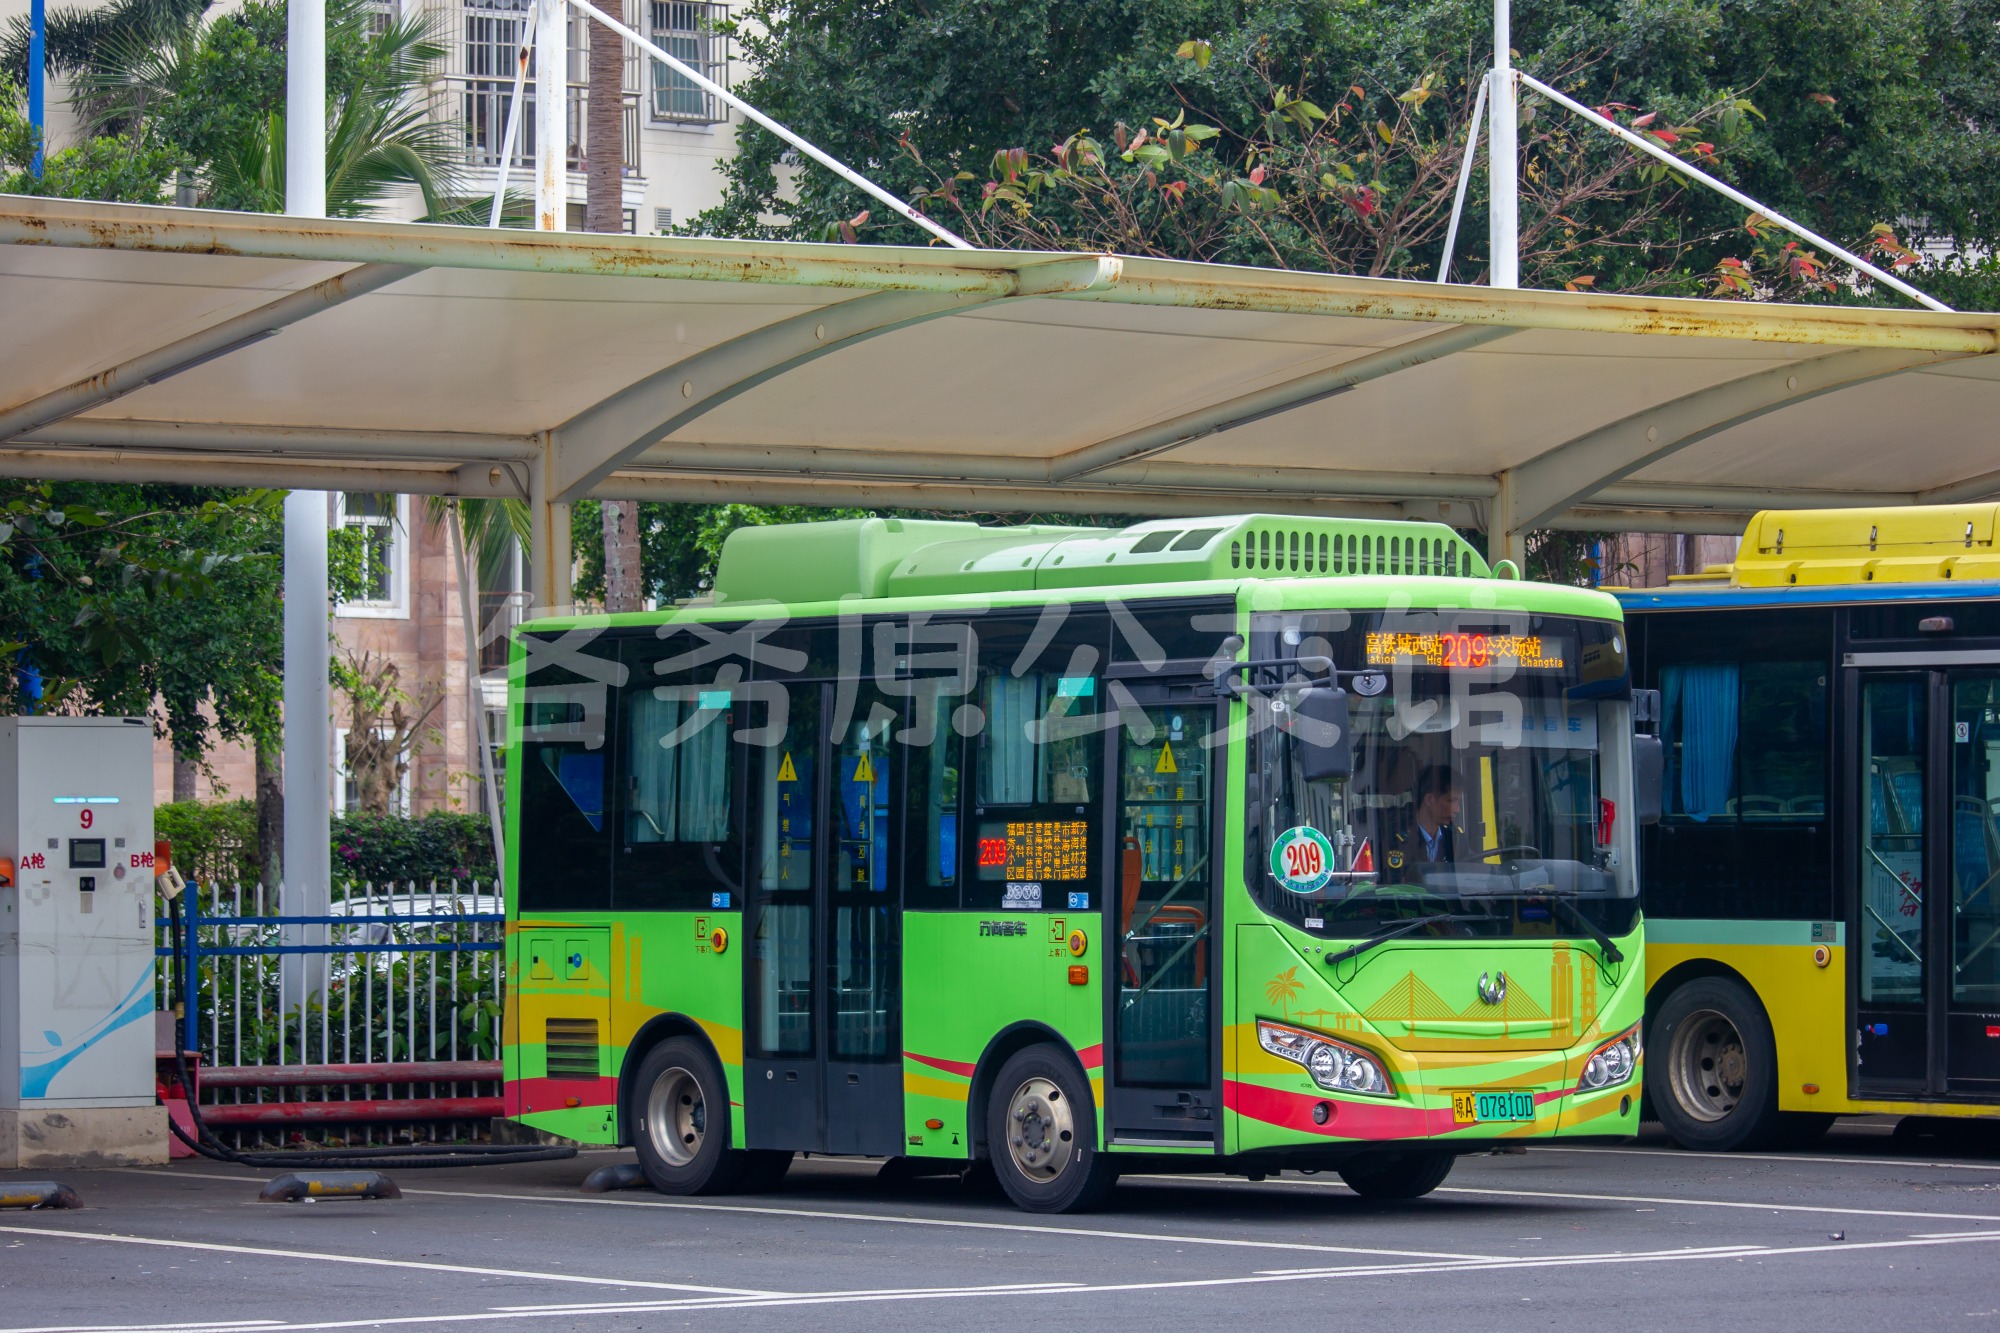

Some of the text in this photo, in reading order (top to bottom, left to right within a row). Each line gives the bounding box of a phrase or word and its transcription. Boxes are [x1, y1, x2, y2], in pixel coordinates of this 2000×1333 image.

[1366, 633, 1443, 656] 高铁城西站
[1442, 633, 1487, 667] 209
[1520, 656, 1564, 668] Changtia
[80, 808, 93, 829] 9
[20, 852, 45, 869] A枪
[130, 851, 155, 868] B枪
[979, 838, 1007, 866] 209
[1286, 842, 1321, 877] 209
